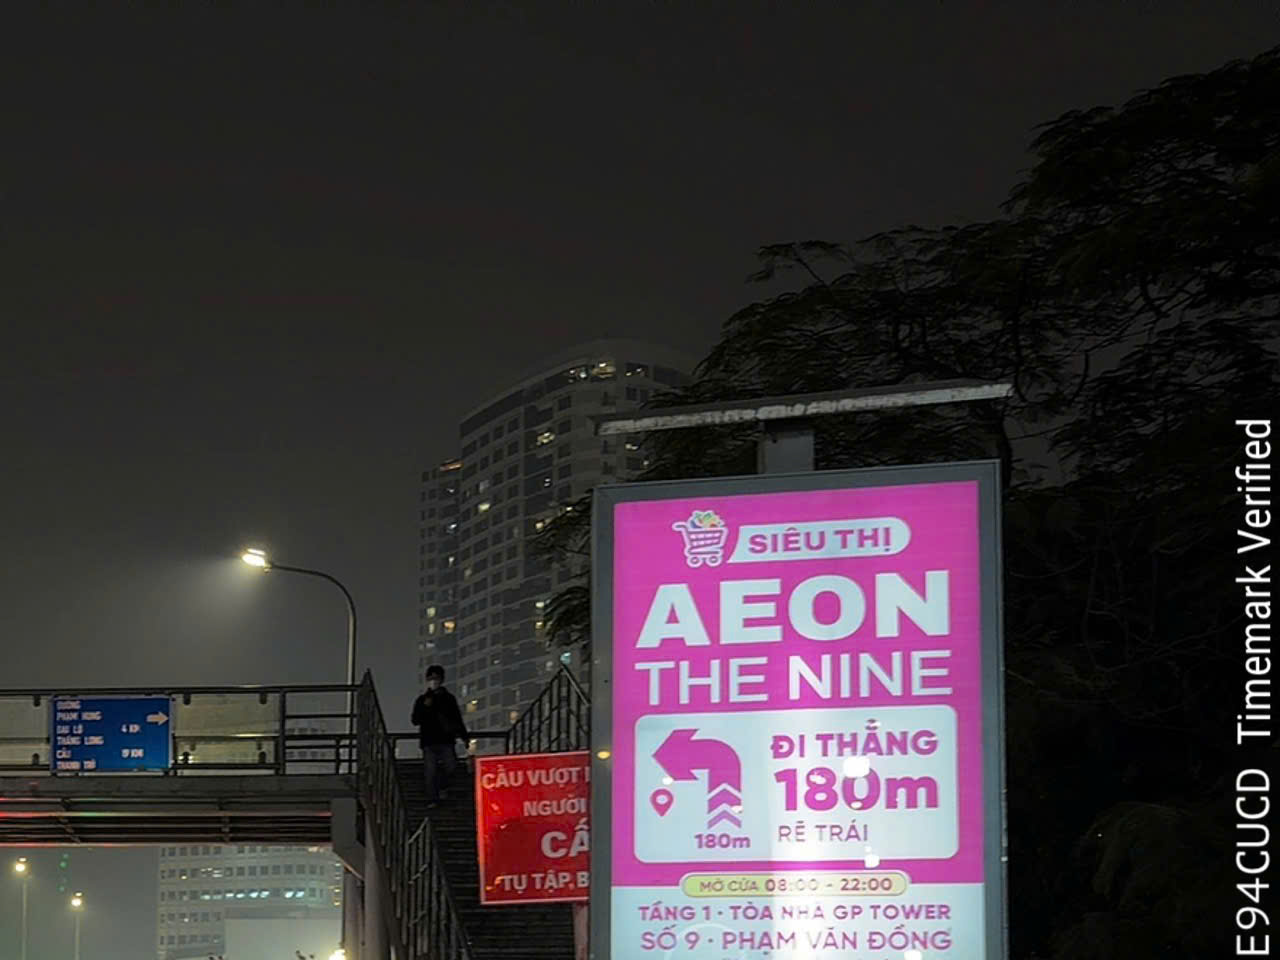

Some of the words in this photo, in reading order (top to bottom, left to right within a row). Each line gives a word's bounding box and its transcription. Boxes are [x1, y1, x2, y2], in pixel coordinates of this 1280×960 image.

[748, 527, 826, 554] SIÊU
[833, 527, 892, 552] THỊ
[635, 570, 950, 648] AEON
[634, 656, 768, 706] THE
[789, 649, 953, 700] NINE
[770, 734, 805, 759] ĐI
[527, 766, 581, 787] VƯỢT
[774, 766, 939, 811] 180m
[523, 795, 586, 816] NGƯỜI
[694, 833, 751, 849] 180m
[816, 820, 869, 842] TRÁI
[503, 874, 527, 893] TỤ
[840, 877, 893, 892] 22:00
[702, 905, 711, 920] 1
[729, 901, 774, 920] TÒA
[833, 904, 862, 919] GP
[870, 903, 951, 919] TOWER
[640, 924, 678, 950] SỐ
[684, 931, 700, 950] 9
[722, 931, 796, 955] PHẠM
